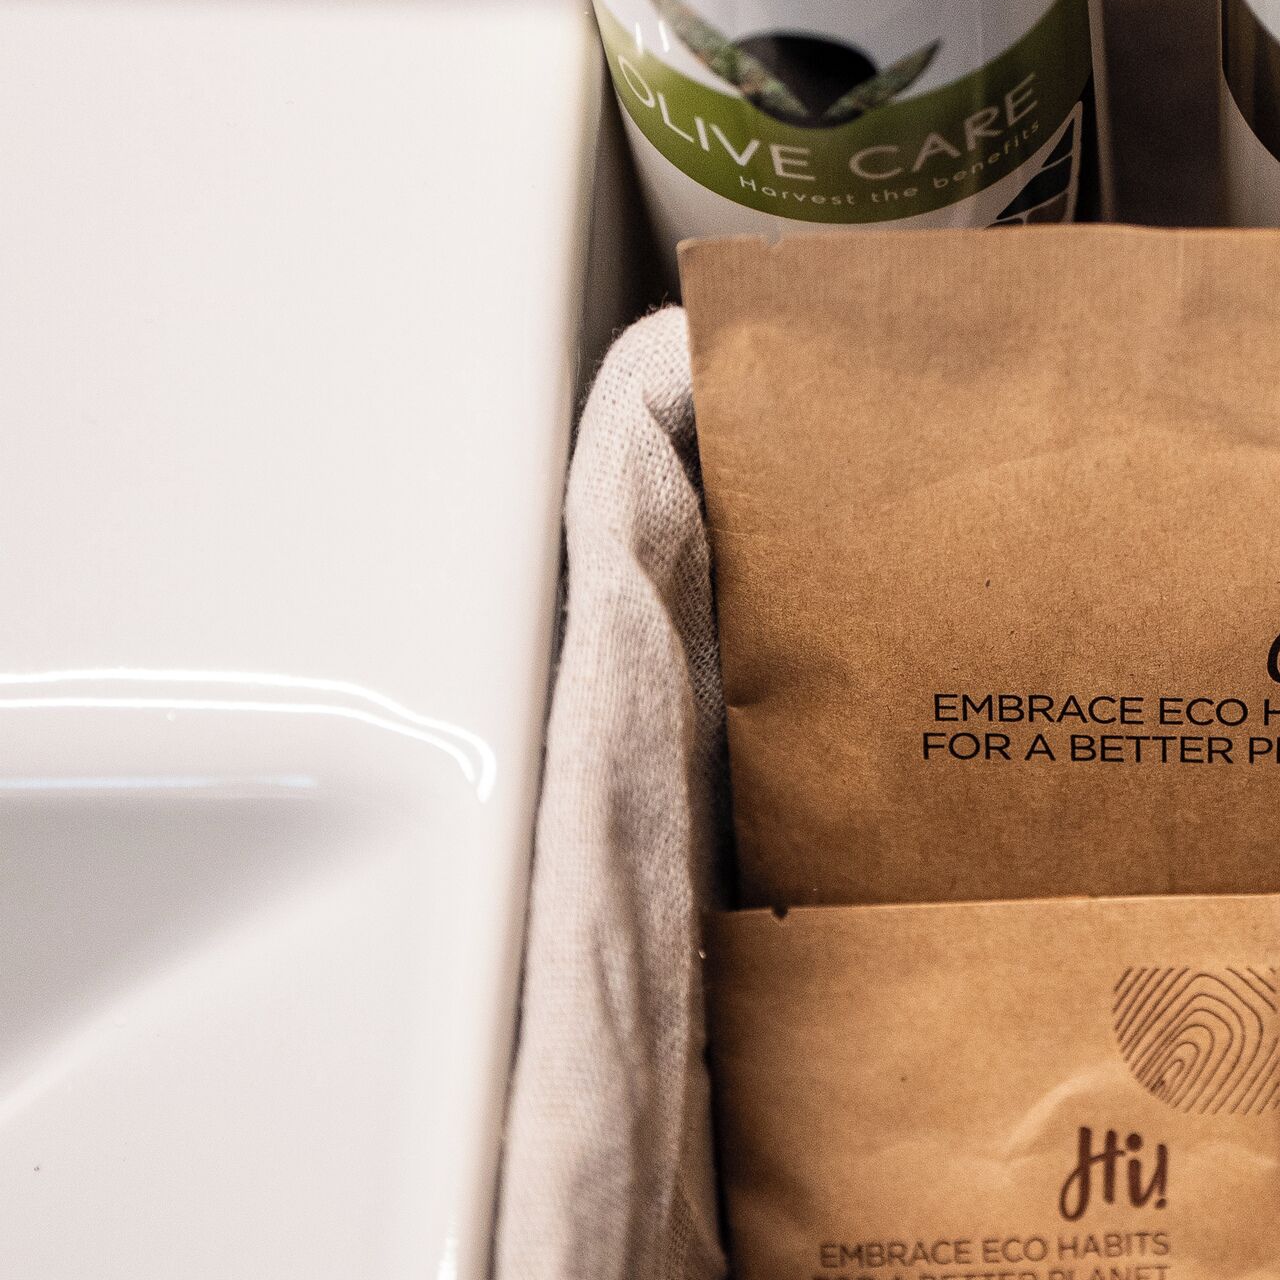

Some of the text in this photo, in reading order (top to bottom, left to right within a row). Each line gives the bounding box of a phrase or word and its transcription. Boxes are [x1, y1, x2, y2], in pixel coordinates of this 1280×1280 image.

[617, 54, 1040, 181] OLIVE CARE
[739, 121, 1041, 206] Harvest the benefits
[933, 692, 1144, 725] EMBRACE
[1158, 697, 1249, 727] ECO
[922, 731, 1012, 762] FOR
[1023, 733, 1057, 762] A
[1069, 734, 1234, 765] BETTER
[1058, 1125, 1169, 1221] Hi!
[819, 1231, 1171, 1269] EMBRACE ECO HABITS
